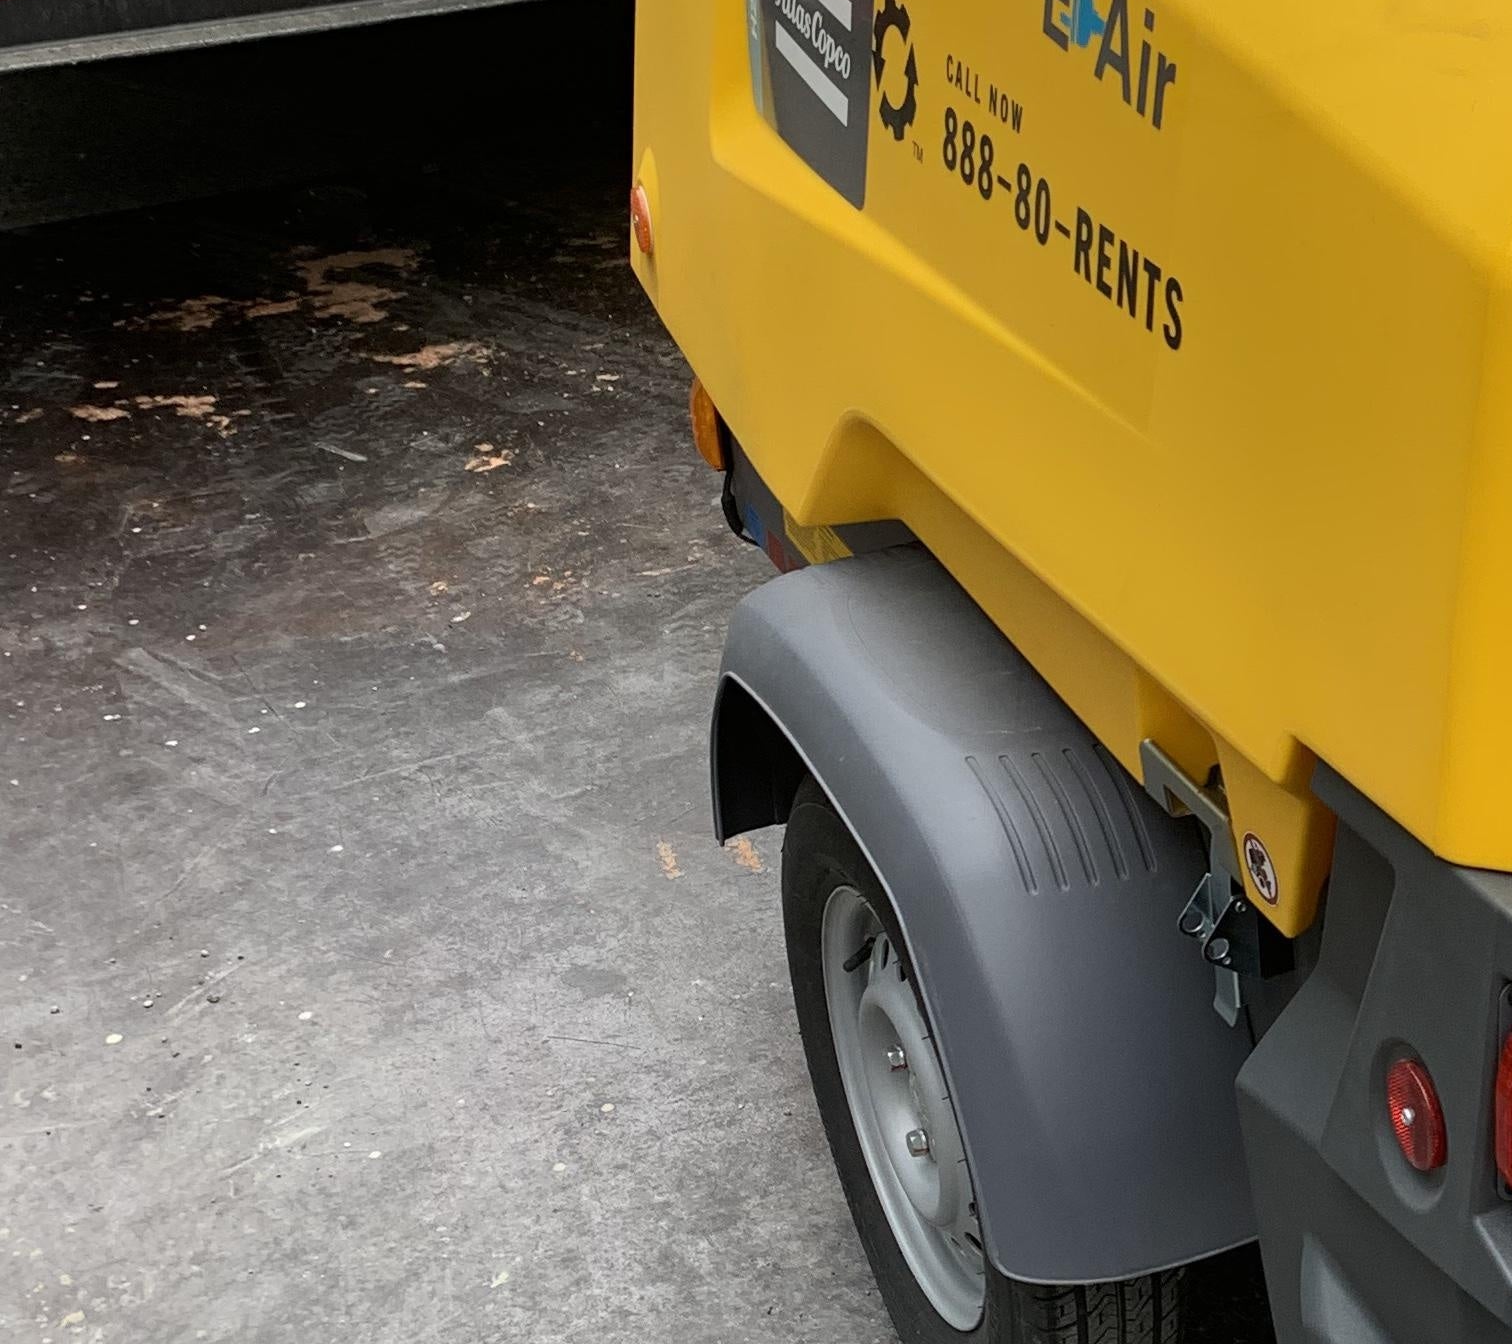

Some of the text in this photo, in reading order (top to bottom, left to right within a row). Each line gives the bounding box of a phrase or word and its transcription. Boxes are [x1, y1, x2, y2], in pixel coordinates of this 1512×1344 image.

[946, 54, 1024, 134] CALL NOW
[943, 107, 1184, 351] 888-80-RENTS
